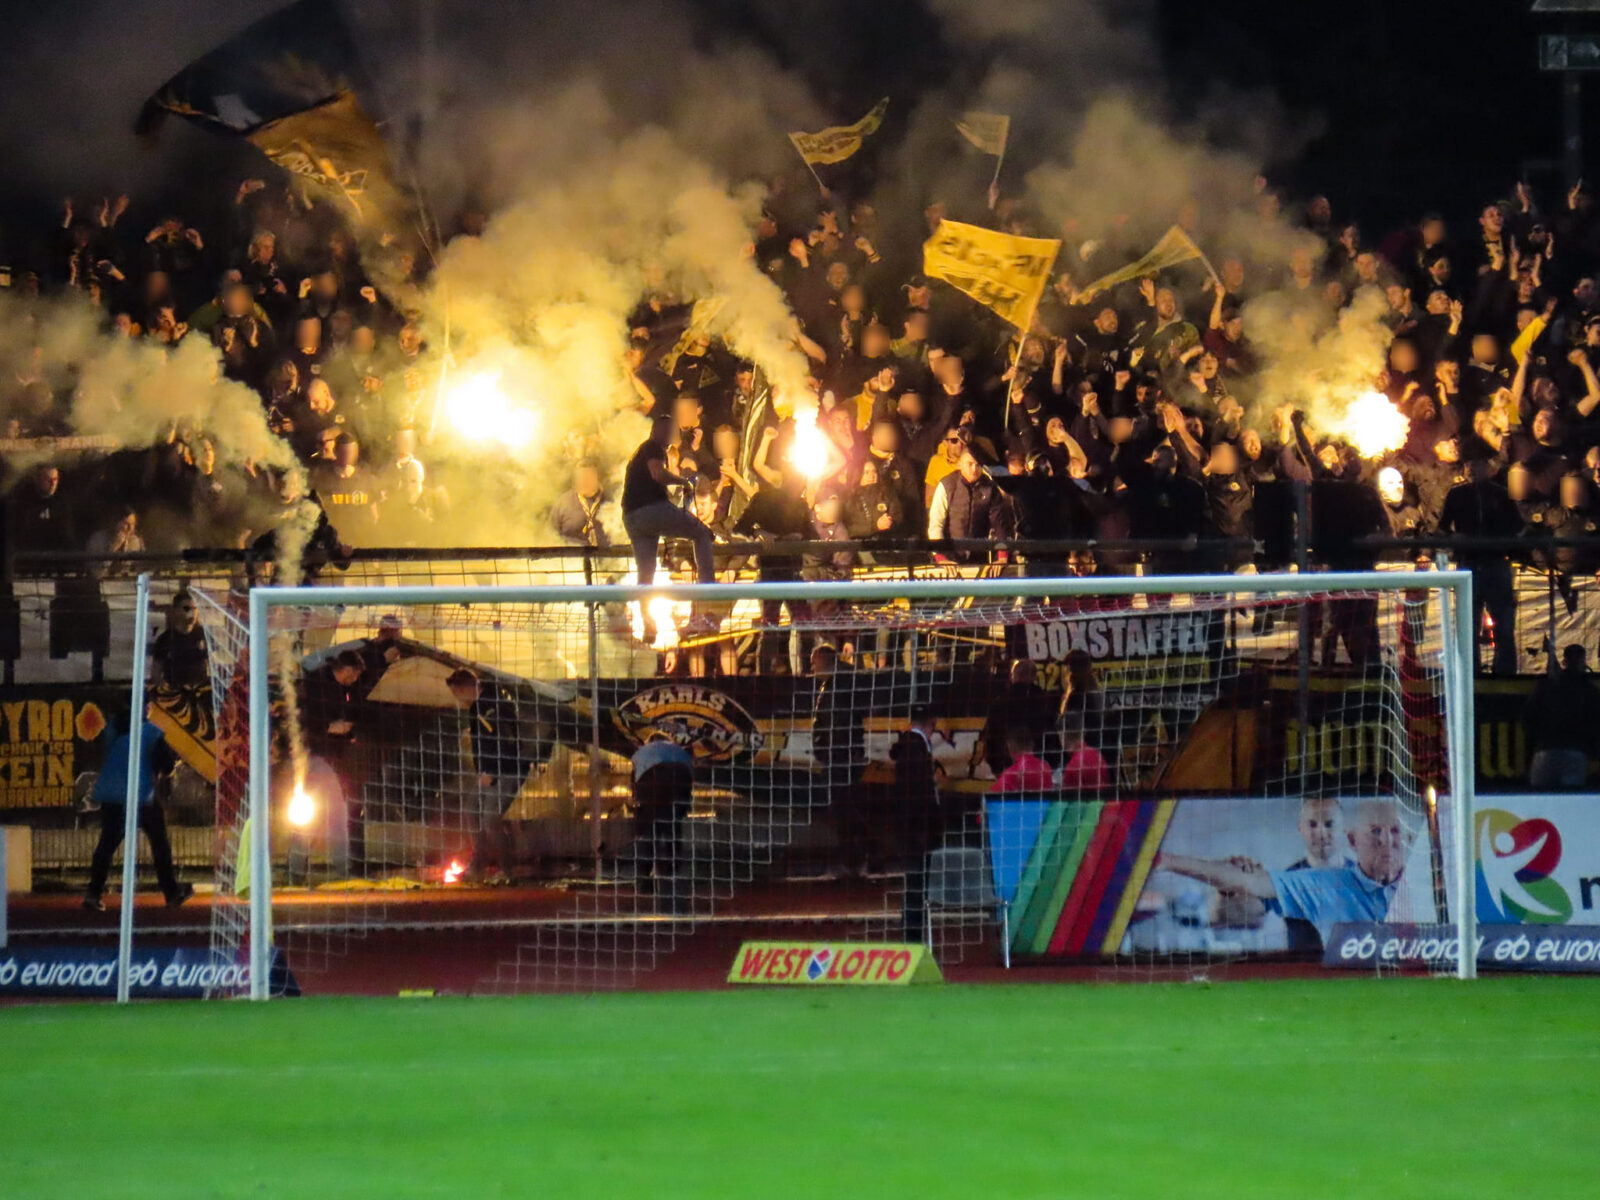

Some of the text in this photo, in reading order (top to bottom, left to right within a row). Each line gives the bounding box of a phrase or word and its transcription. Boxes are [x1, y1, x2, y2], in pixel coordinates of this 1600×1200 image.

[0, 699, 74, 742] YRO
[740, 948, 911, 981] WEST LOTTO
[1535, 939, 1600, 961] euror
[21, 958, 117, 986] eurorad
